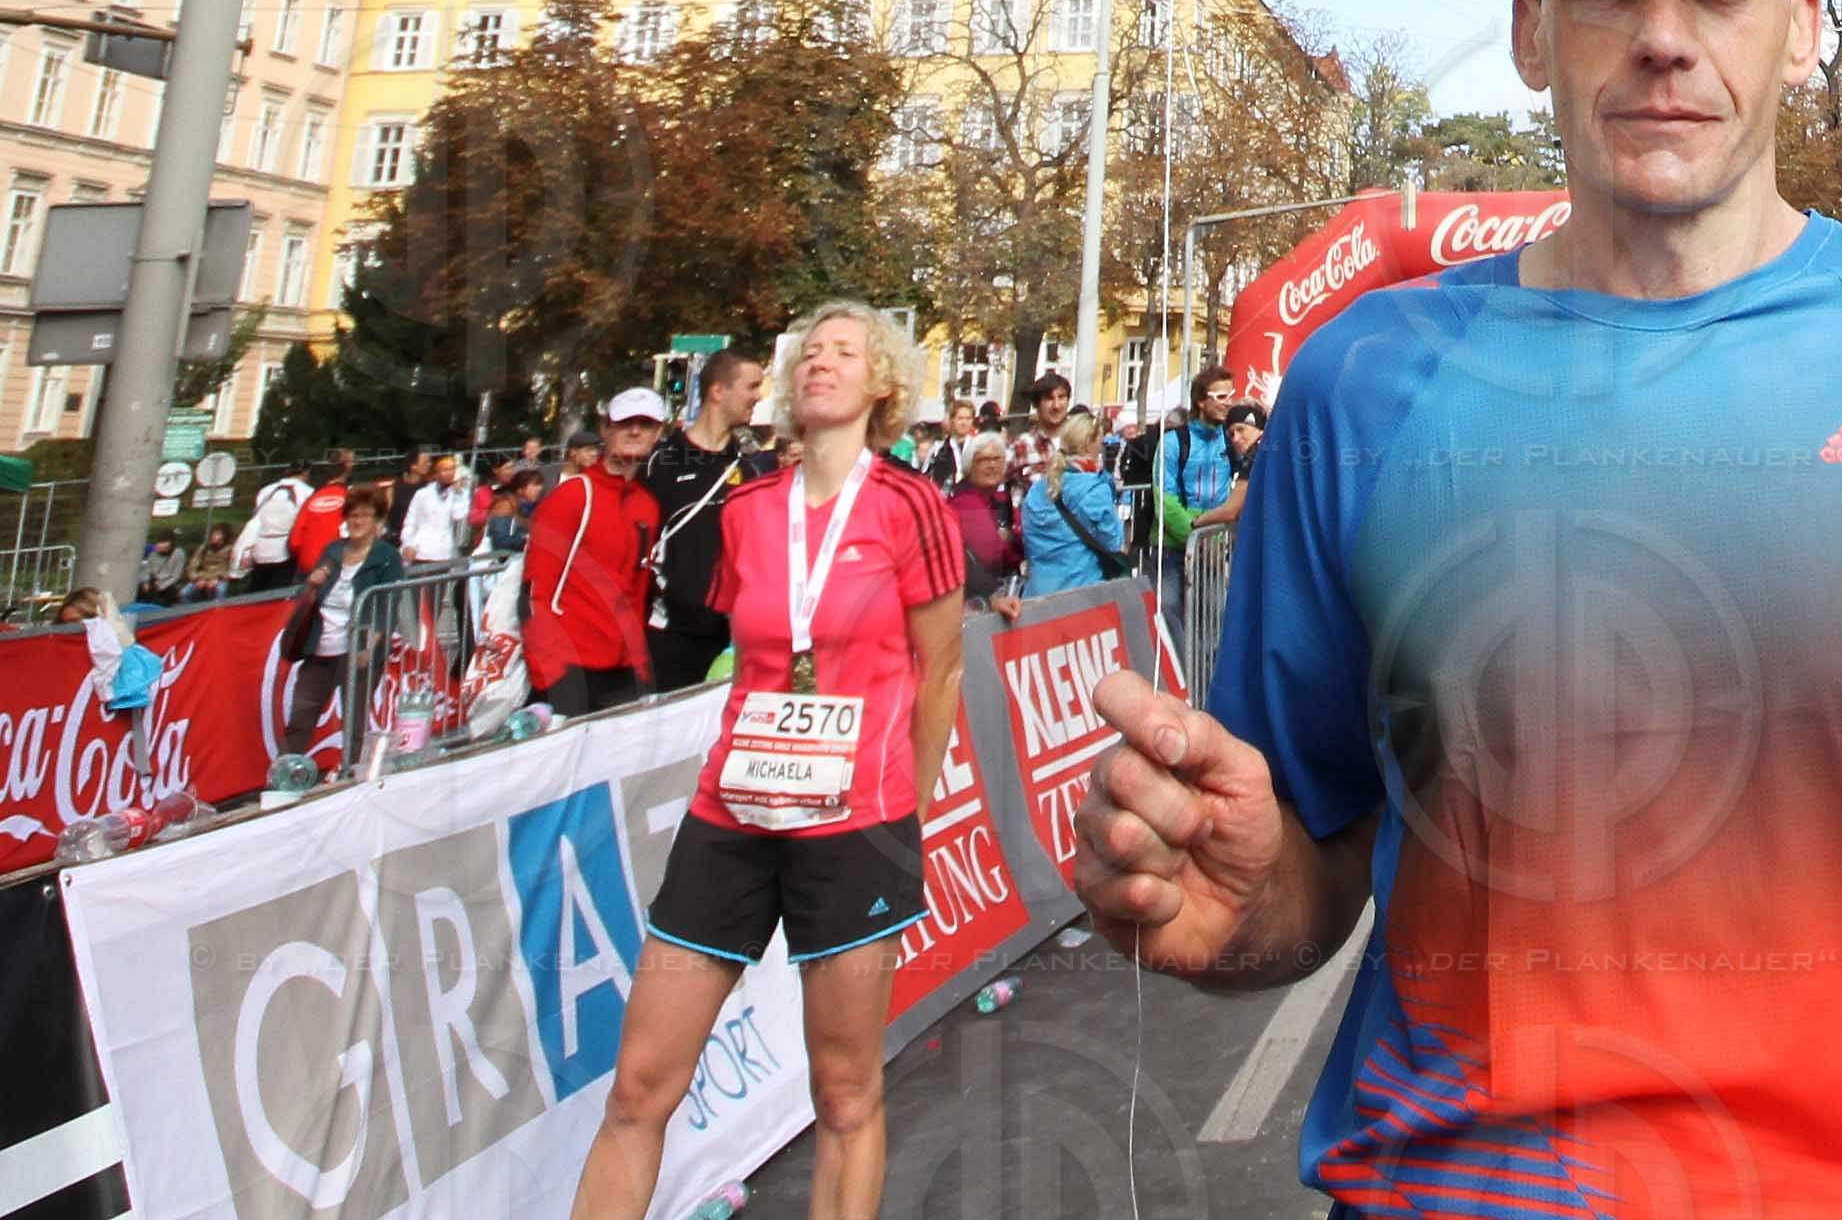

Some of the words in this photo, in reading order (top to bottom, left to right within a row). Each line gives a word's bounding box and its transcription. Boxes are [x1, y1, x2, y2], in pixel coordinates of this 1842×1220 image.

[1279, 220, 1377, 326] Coca-Cola
[776, 701, 856, 735] 2570
[745, 760, 814, 781] MICHAELA
[234, 797, 688, 1209] GRA
